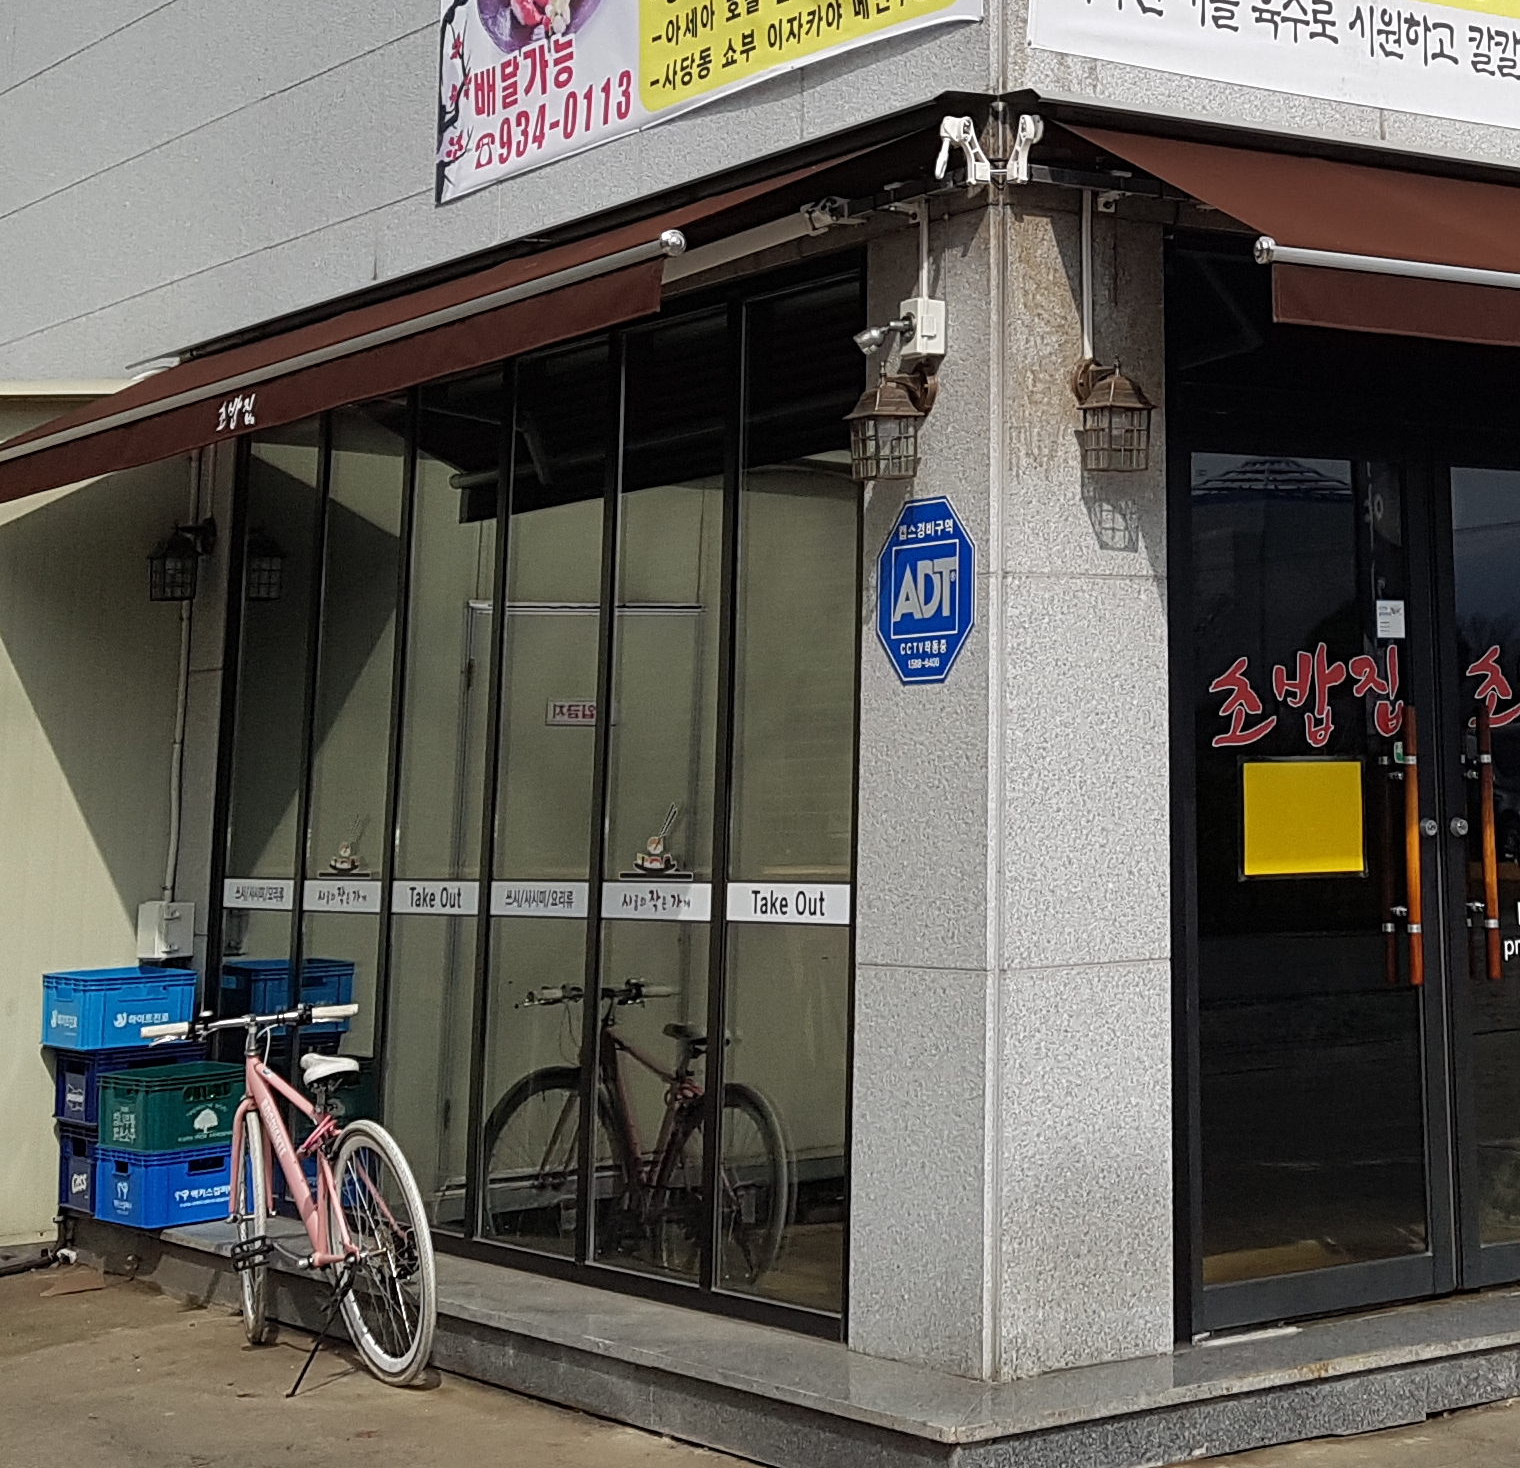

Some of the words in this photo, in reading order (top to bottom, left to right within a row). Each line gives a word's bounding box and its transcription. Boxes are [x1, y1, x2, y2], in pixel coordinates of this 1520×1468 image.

[721, 28, 757, 71] 쇼부
[1349, 4, 1459, 68] 시원하고
[473, 37, 575, 118] 배달가능
[893, 556, 957, 622] ADT
[1209, 642, 1404, 748] 초밥집
[409, 887, 436, 908] Take
[440, 887, 461, 909] Out
[751, 890, 789, 916] Take
[795, 891, 825, 917] Out
